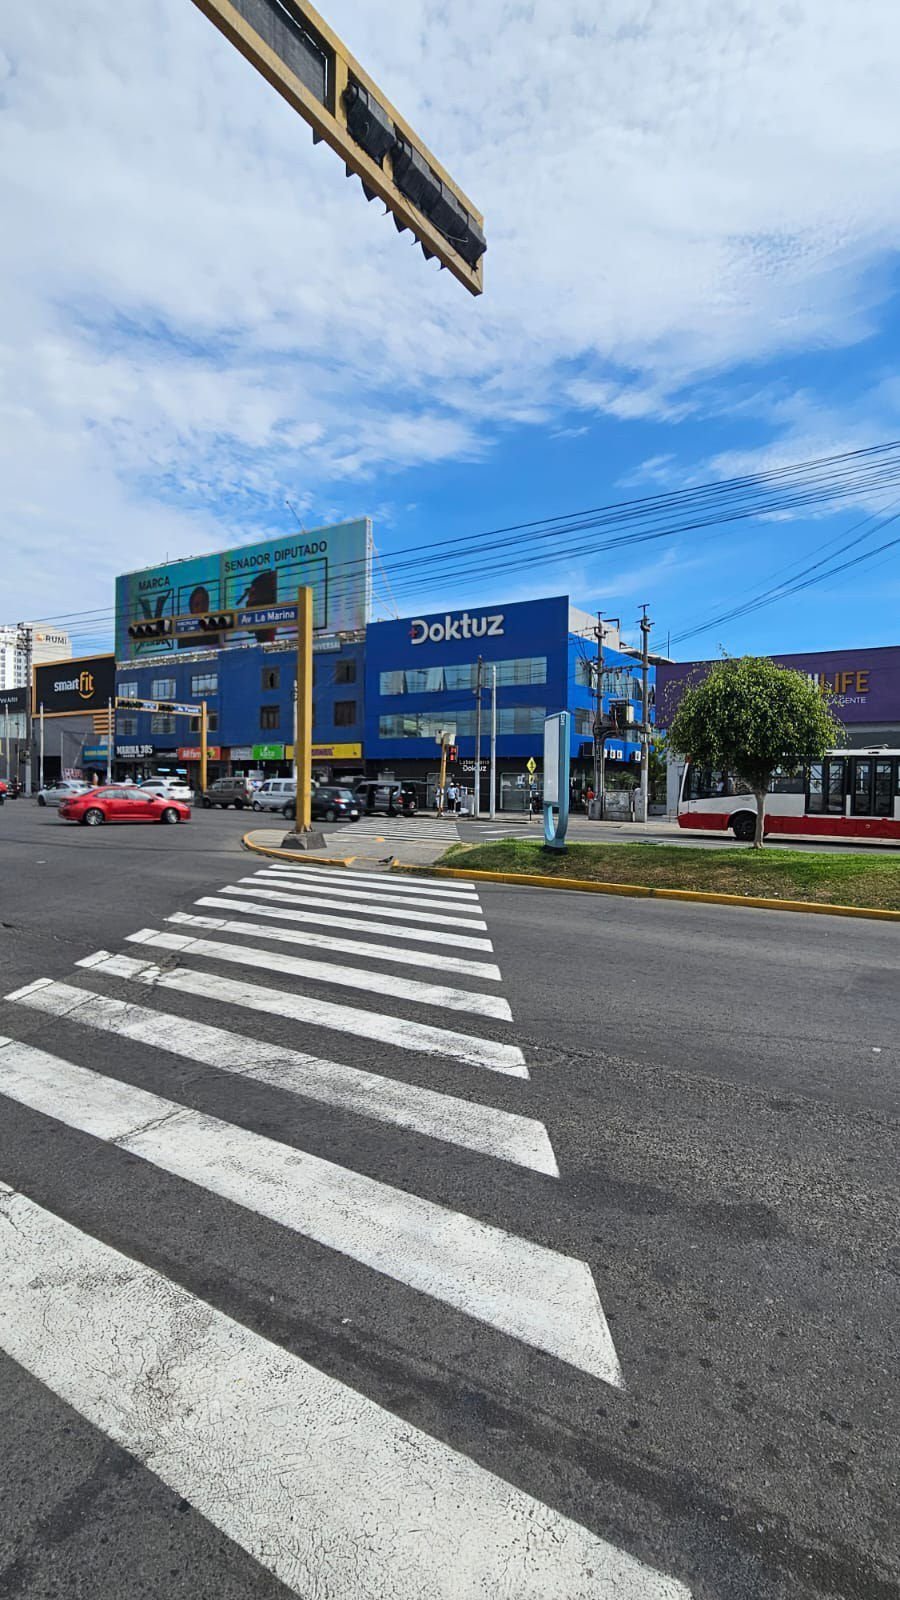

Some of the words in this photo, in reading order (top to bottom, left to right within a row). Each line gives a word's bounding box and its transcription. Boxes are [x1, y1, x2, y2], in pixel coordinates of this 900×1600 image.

[224, 553, 271, 572] SENADOR
[274, 541, 328, 561] DIPUTADO
[138, 576, 170, 590] MARCA
[241, 615, 251, 624] Av
[255, 613, 265, 623] La
[267, 610, 295, 621] Marina
[409, 613, 504, 645] Doktuz
